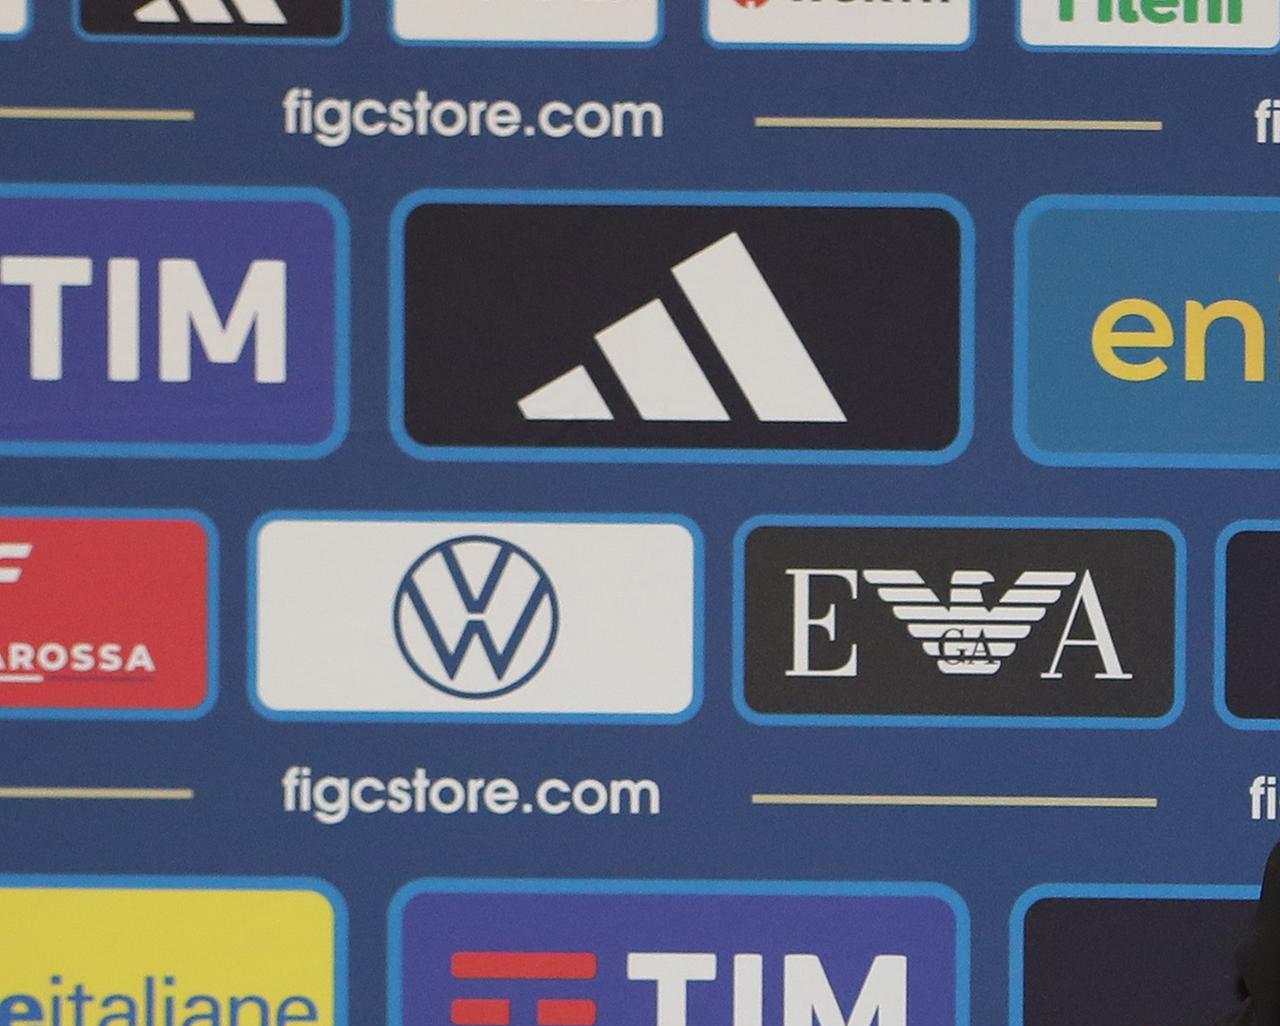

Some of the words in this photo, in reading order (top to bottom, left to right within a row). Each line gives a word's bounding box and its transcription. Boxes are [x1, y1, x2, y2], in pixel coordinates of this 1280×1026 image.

[283, 88, 662, 146] figcstore.com
[0, 256, 286, 383] TIM
[282, 767, 659, 824] figcstore.com
